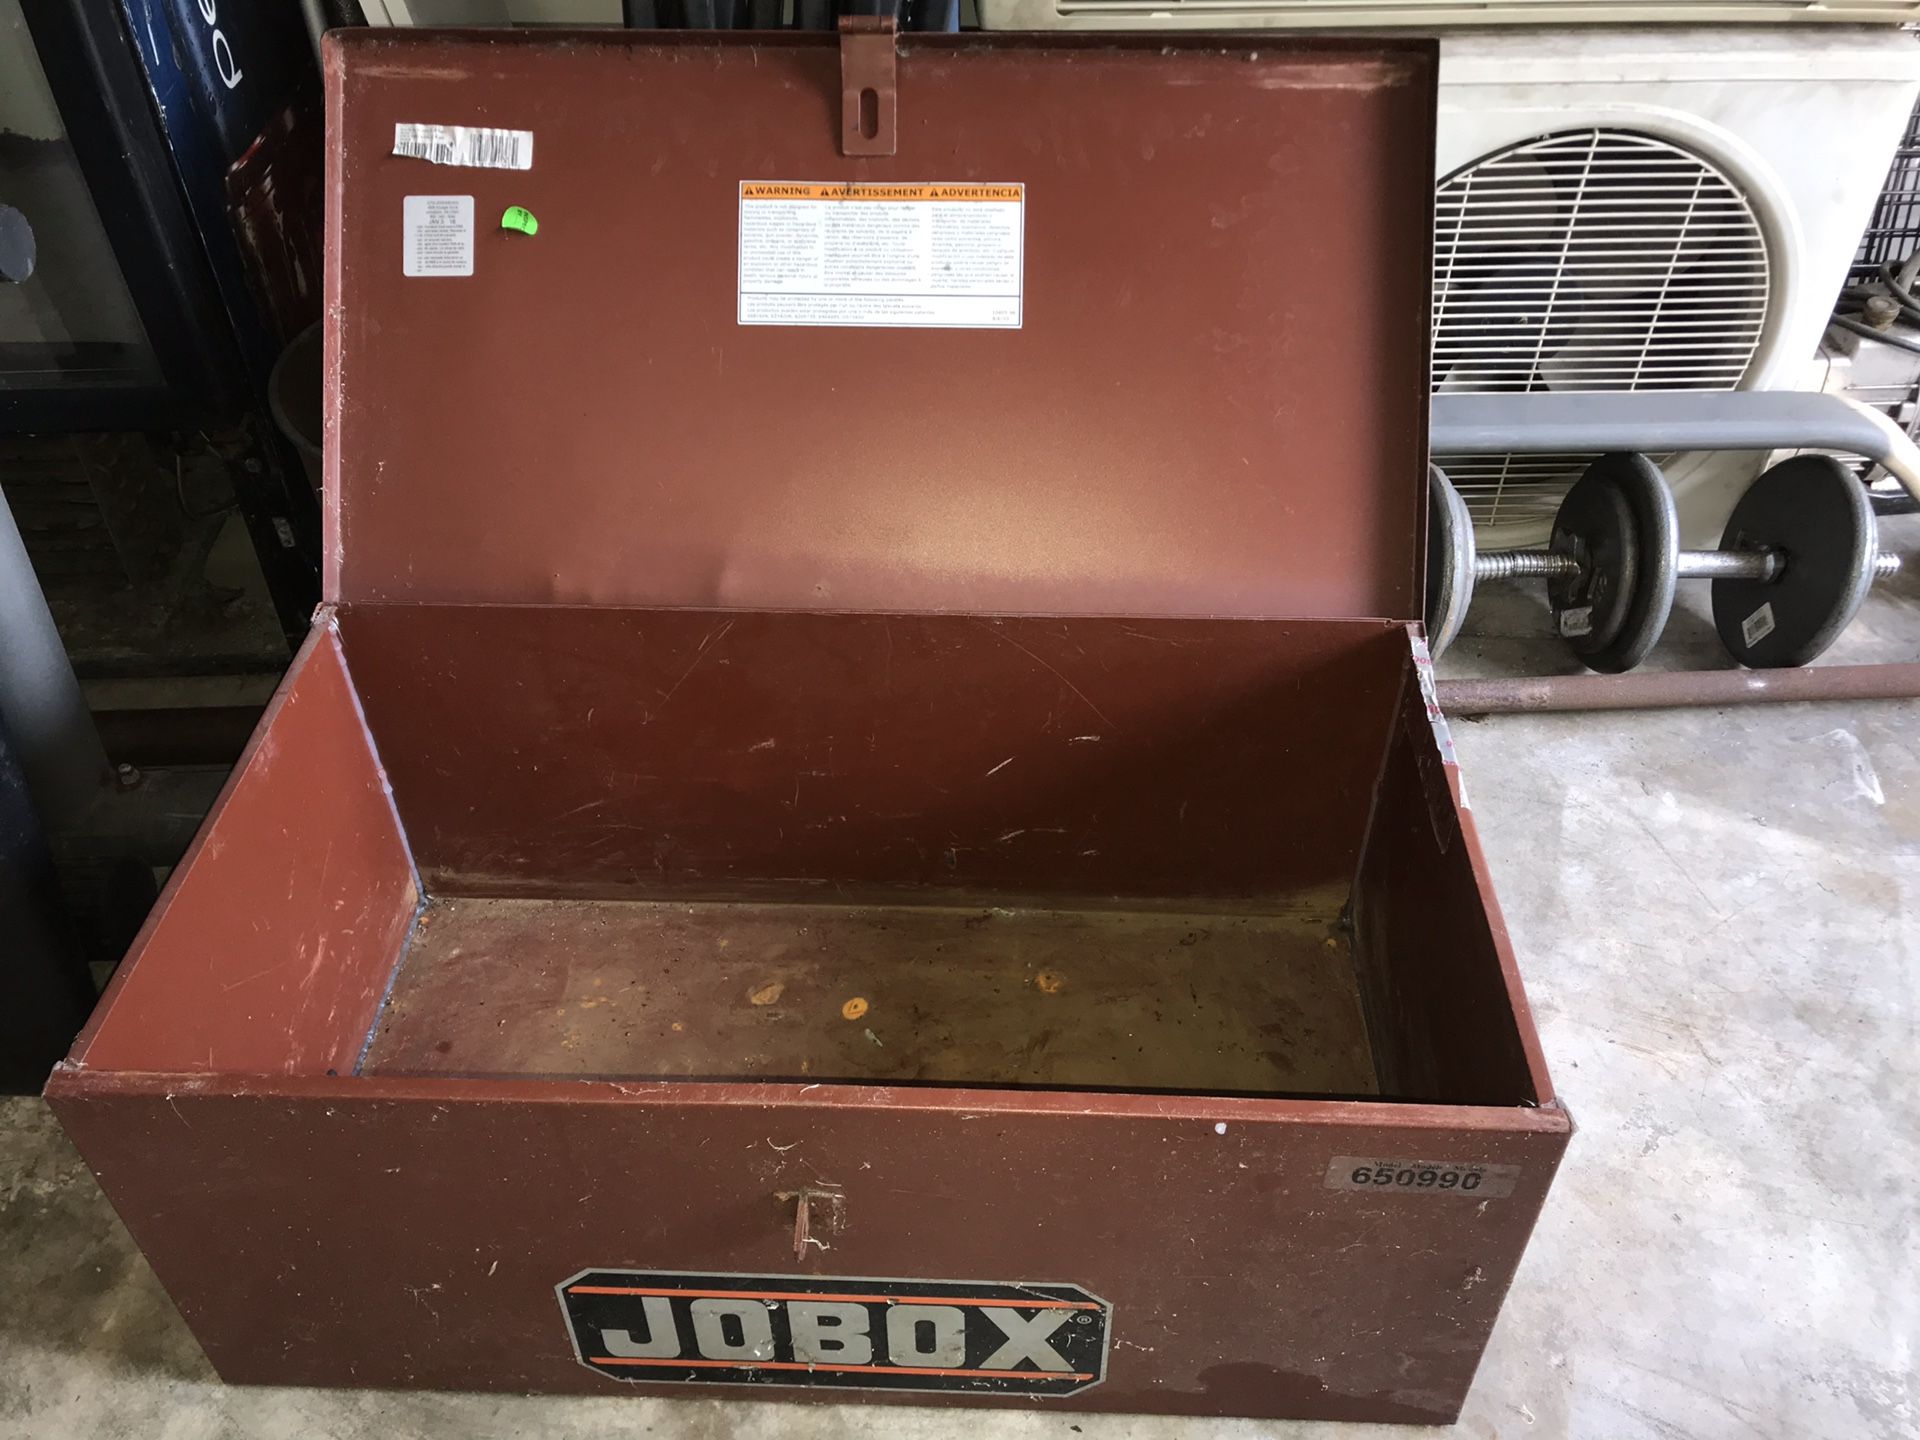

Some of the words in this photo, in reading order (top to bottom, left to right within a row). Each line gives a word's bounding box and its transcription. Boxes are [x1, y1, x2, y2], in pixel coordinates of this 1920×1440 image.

[755, 186, 811, 195] WARNING
[831, 187, 924, 197] AVERTISSEMENT
[941, 188, 1020, 197] ADVERTENCIA
[1351, 1166, 1482, 1191] 650990
[602, 1295, 1079, 1373] JOBOX
